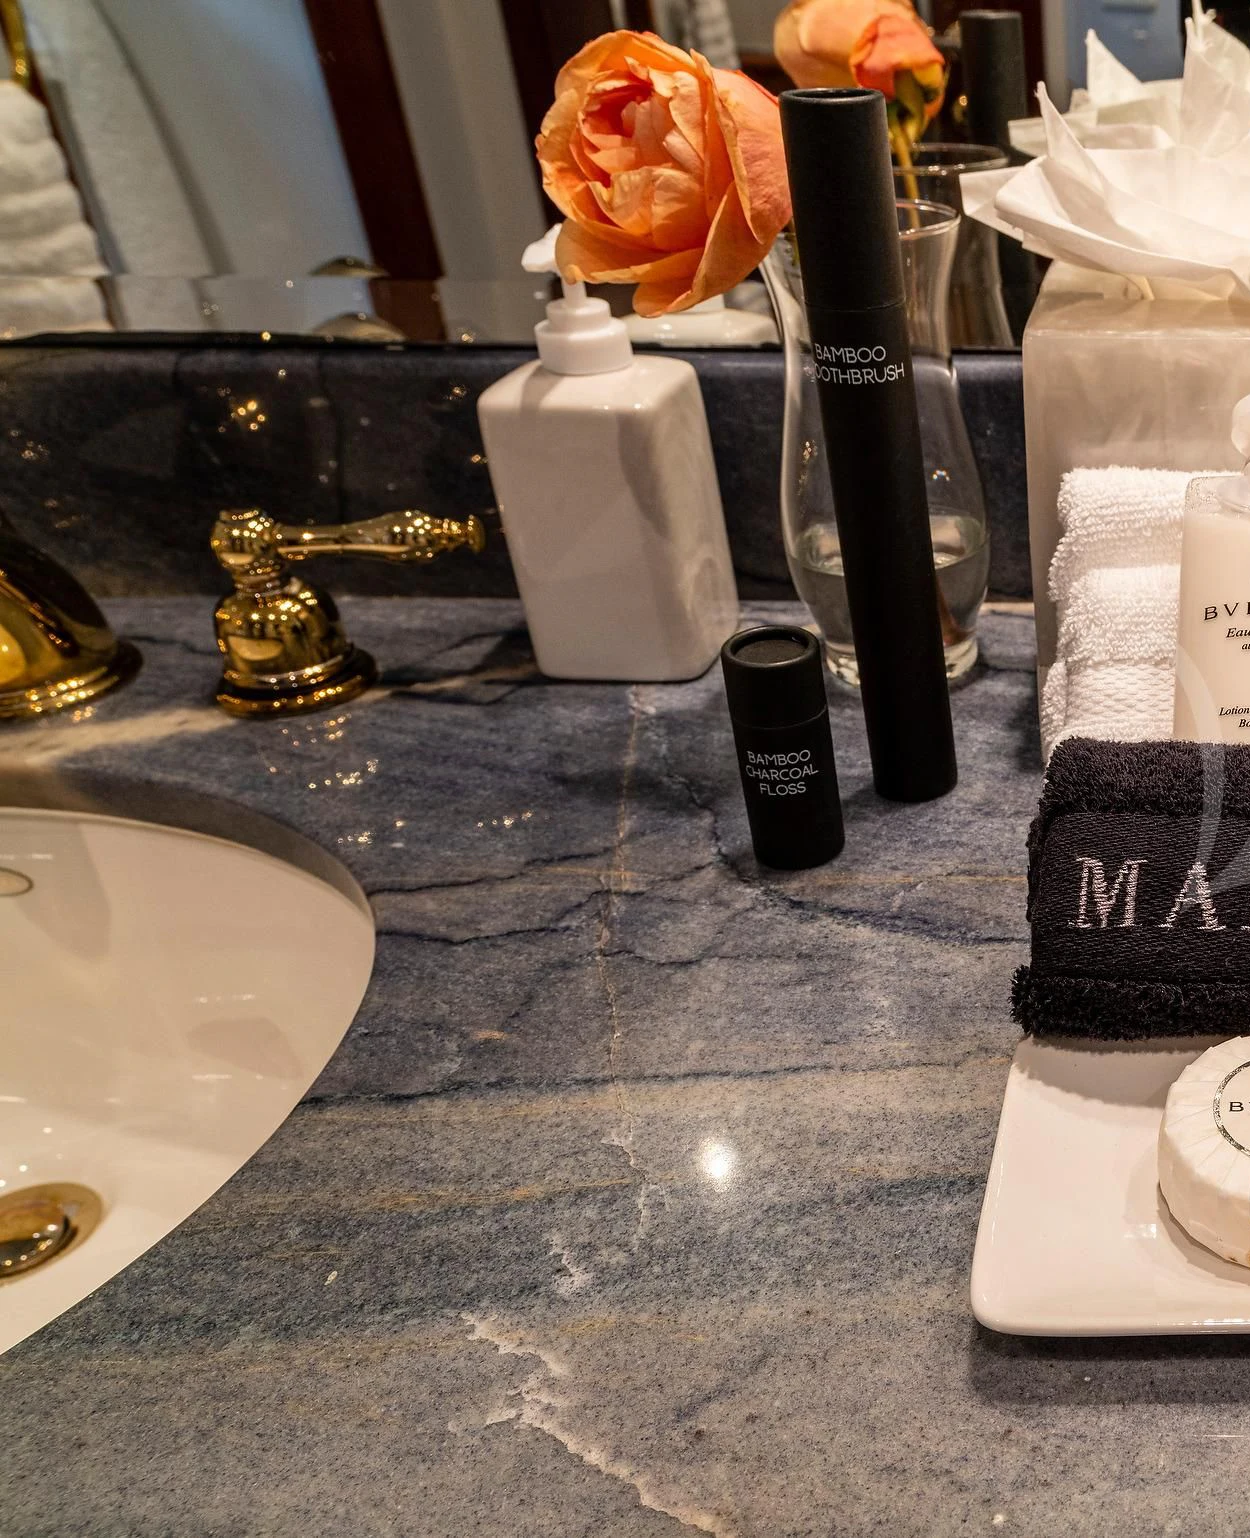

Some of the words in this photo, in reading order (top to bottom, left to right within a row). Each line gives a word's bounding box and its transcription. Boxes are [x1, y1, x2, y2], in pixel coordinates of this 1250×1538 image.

[814, 343, 887, 364] BAMBOO
[812, 361, 905, 385] OOTHBRUSH
[1219, 706, 1250, 716] Lotion
[746, 749, 811, 766] BAMBOO
[745, 763, 819, 781] CHARCOAL
[759, 781, 807, 796] FLOSS
